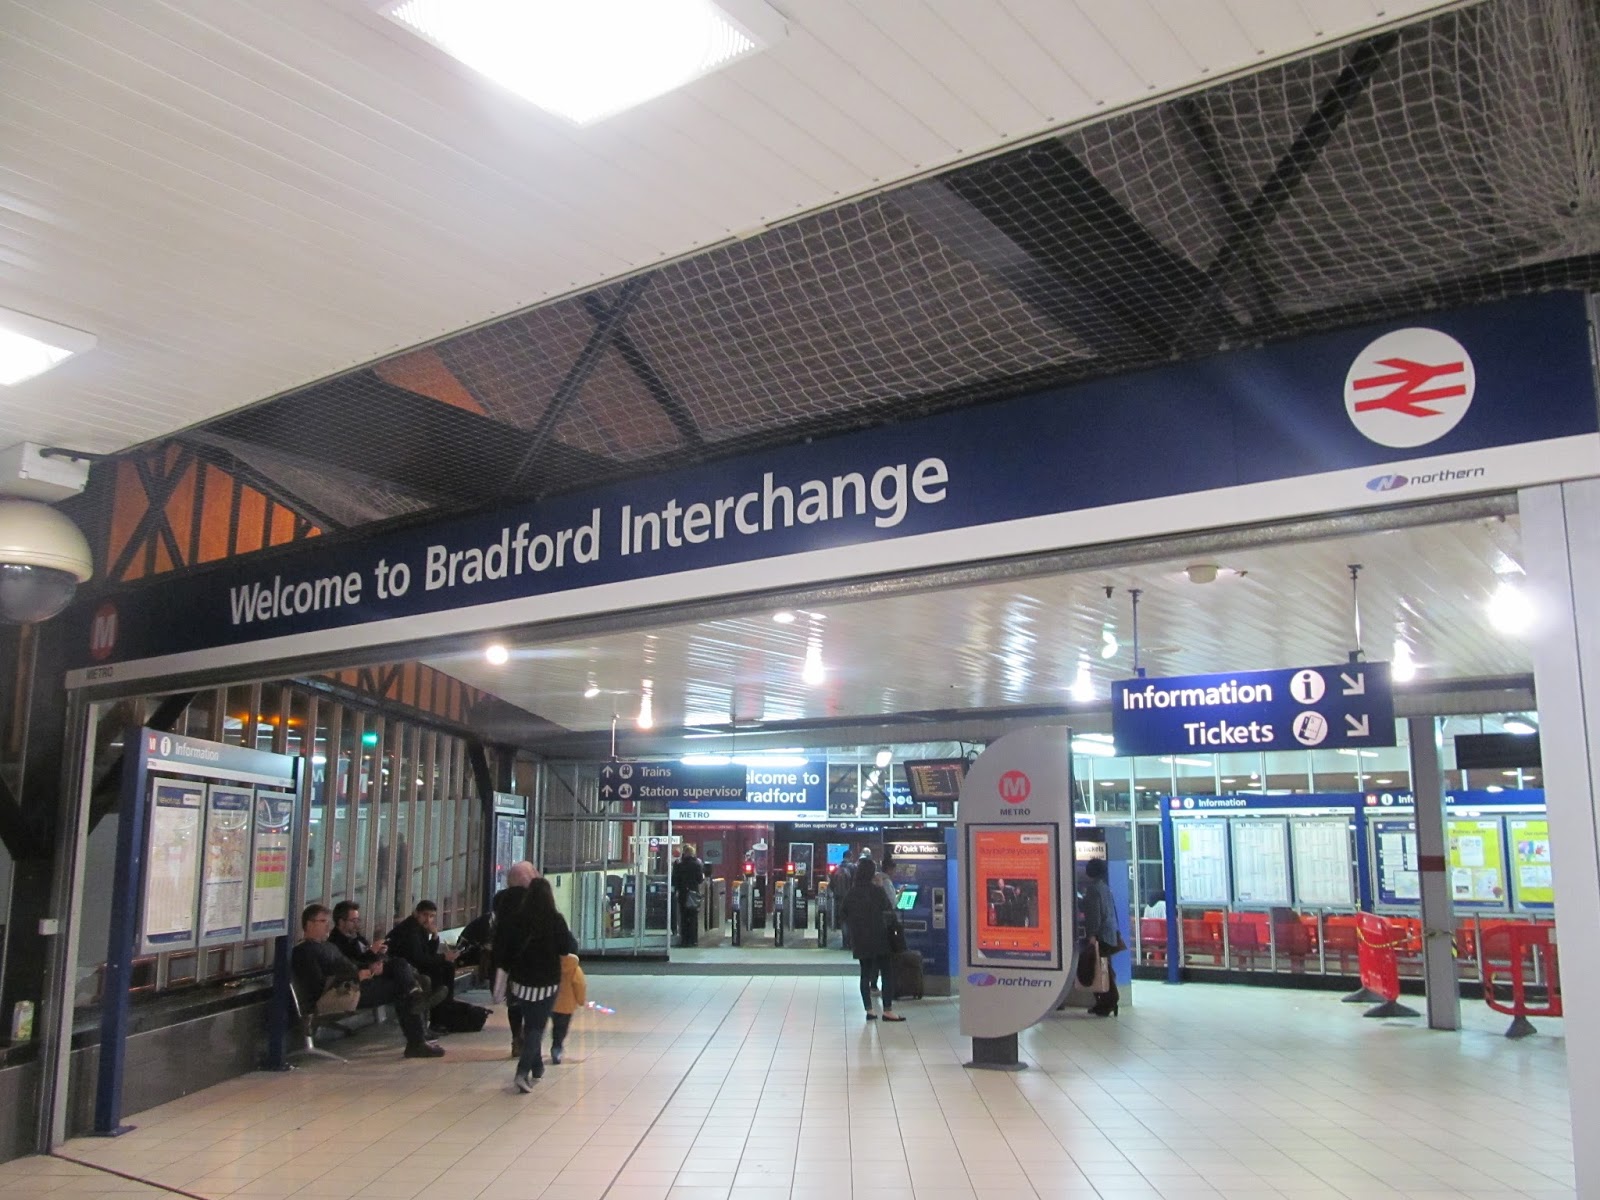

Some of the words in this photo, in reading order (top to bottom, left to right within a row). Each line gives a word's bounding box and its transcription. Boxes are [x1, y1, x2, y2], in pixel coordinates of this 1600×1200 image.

[1411, 467, 1484, 485] northern
[230, 576, 362, 625] Welcome
[375, 558, 411, 599] to
[425, 508, 601, 591] Bradford
[620, 457, 949, 556] Interchange
[1123, 680, 1272, 710] Information
[1184, 720, 1274, 745] Tickets
[175, 743, 219, 761] Information
[641, 767, 671, 777] Trains
[803, 771, 819, 785] to
[640, 786, 678, 797] Station
[683, 786, 743, 799] supervisor
[1003, 777, 1026, 797] M
[746, 788, 806, 804] radford
[1199, 798, 1247, 808] Information
[679, 811, 709, 819] METRO
[1000, 808, 1031, 816] METRO
[902, 845, 918, 854] Quick
[919, 845, 939, 853] Tickets
[998, 977, 1051, 987] northern
